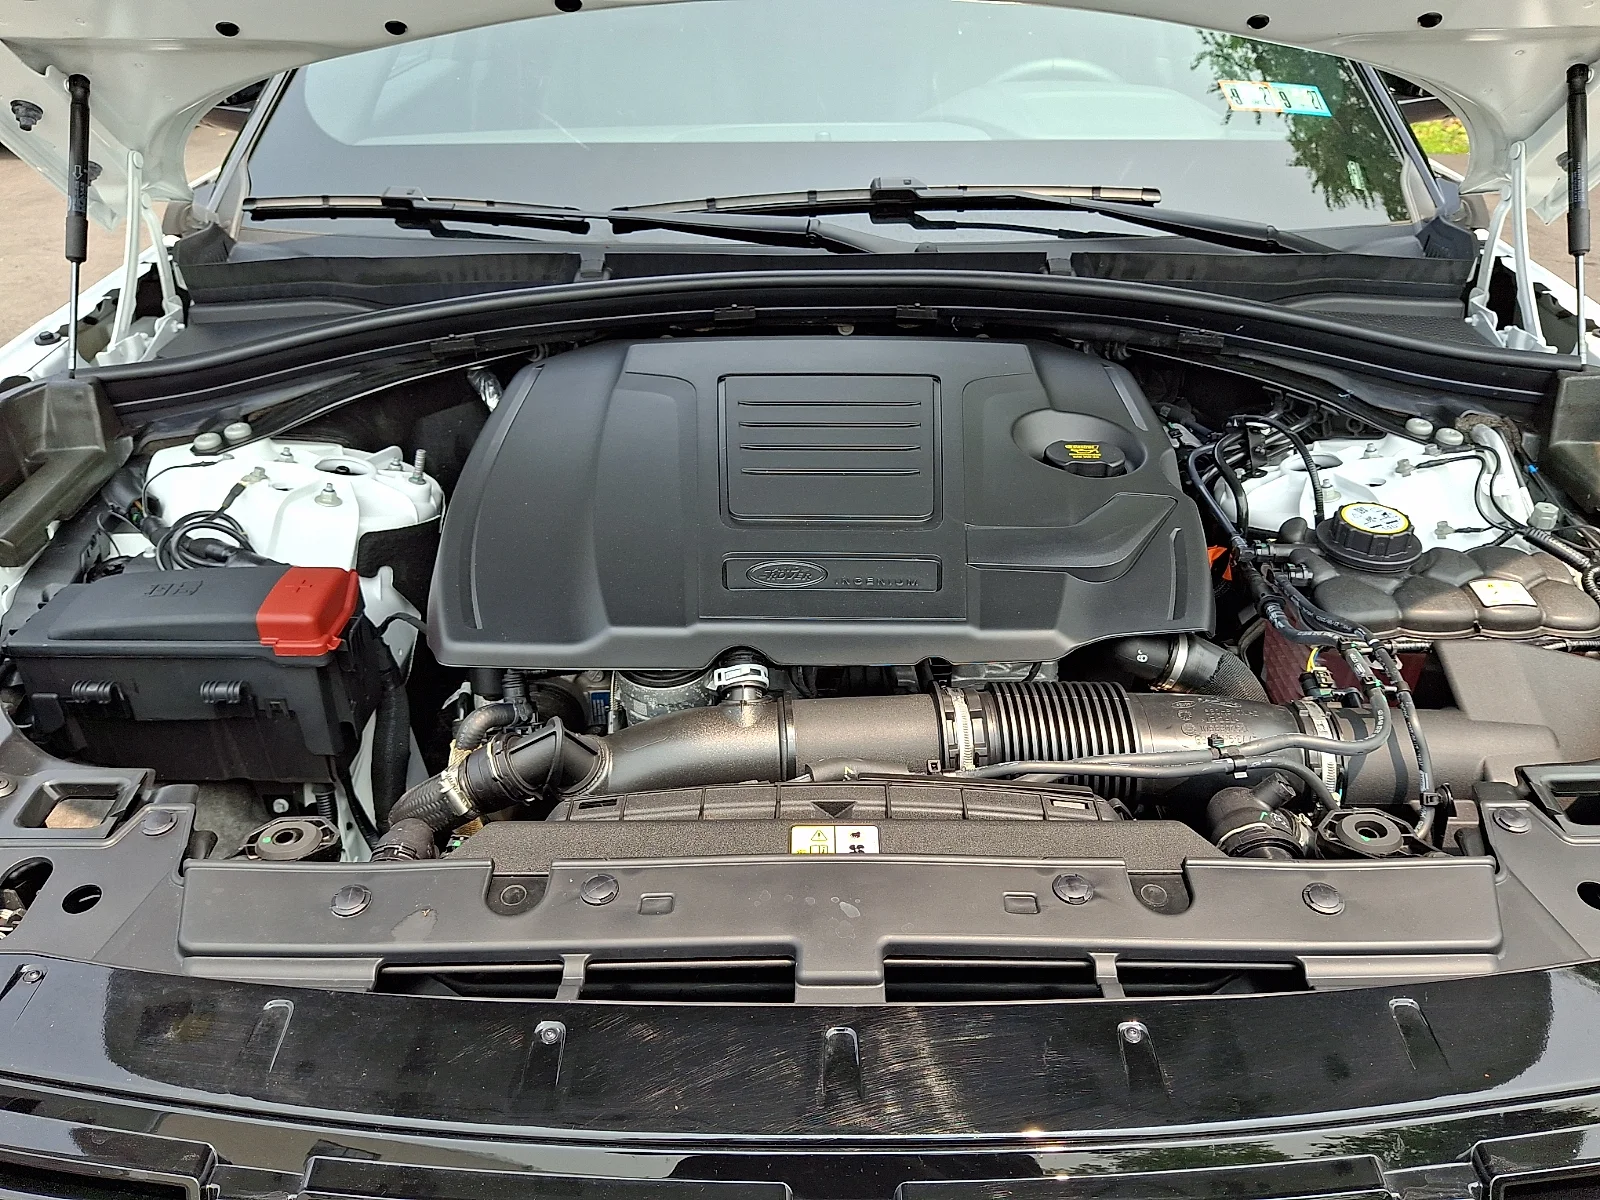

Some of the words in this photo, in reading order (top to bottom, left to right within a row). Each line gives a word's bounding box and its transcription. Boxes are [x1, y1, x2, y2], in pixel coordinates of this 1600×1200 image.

[1279, 91, 1292, 108] 9
[1307, 90, 1323, 110] 27
[767, 571, 812, 581] ROVER
[835, 576, 919, 586] INGENIUM
